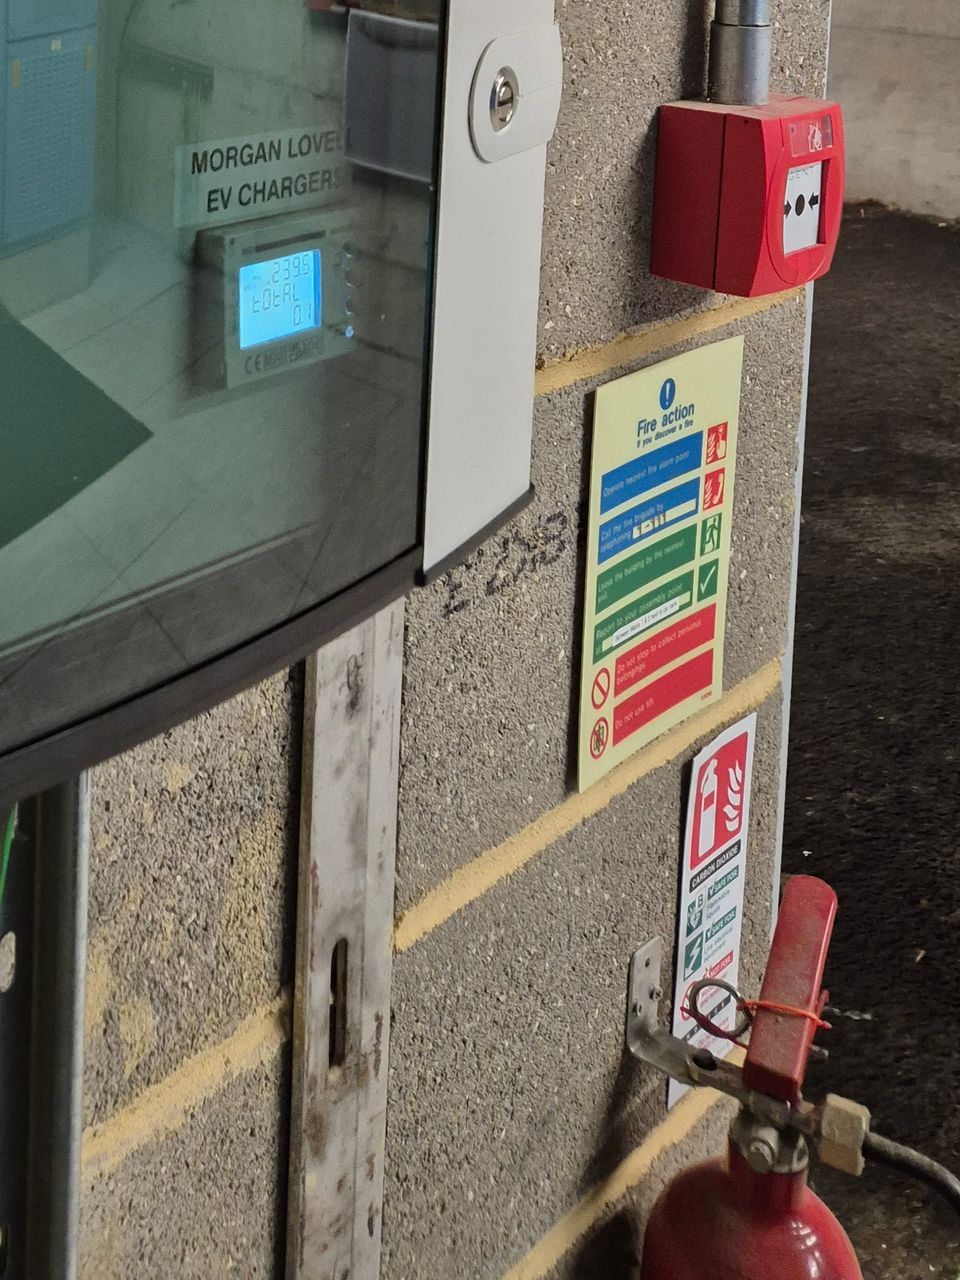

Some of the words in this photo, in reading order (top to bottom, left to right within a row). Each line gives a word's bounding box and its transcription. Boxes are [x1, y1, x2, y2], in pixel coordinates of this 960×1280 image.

[191, 138, 282, 175] MORGAN
[207, 185, 233, 213] EV
[637, 418, 657, 437] Fire
[661, 403, 695, 427] action
[642, 436, 652, 448] you
[654, 426, 677, 440] discover
[684, 419, 694, 429] fire
[692, 862, 716, 888] CARBON
[716, 844, 739, 868] DIOXIDE
[697, 893, 703, 908] B
